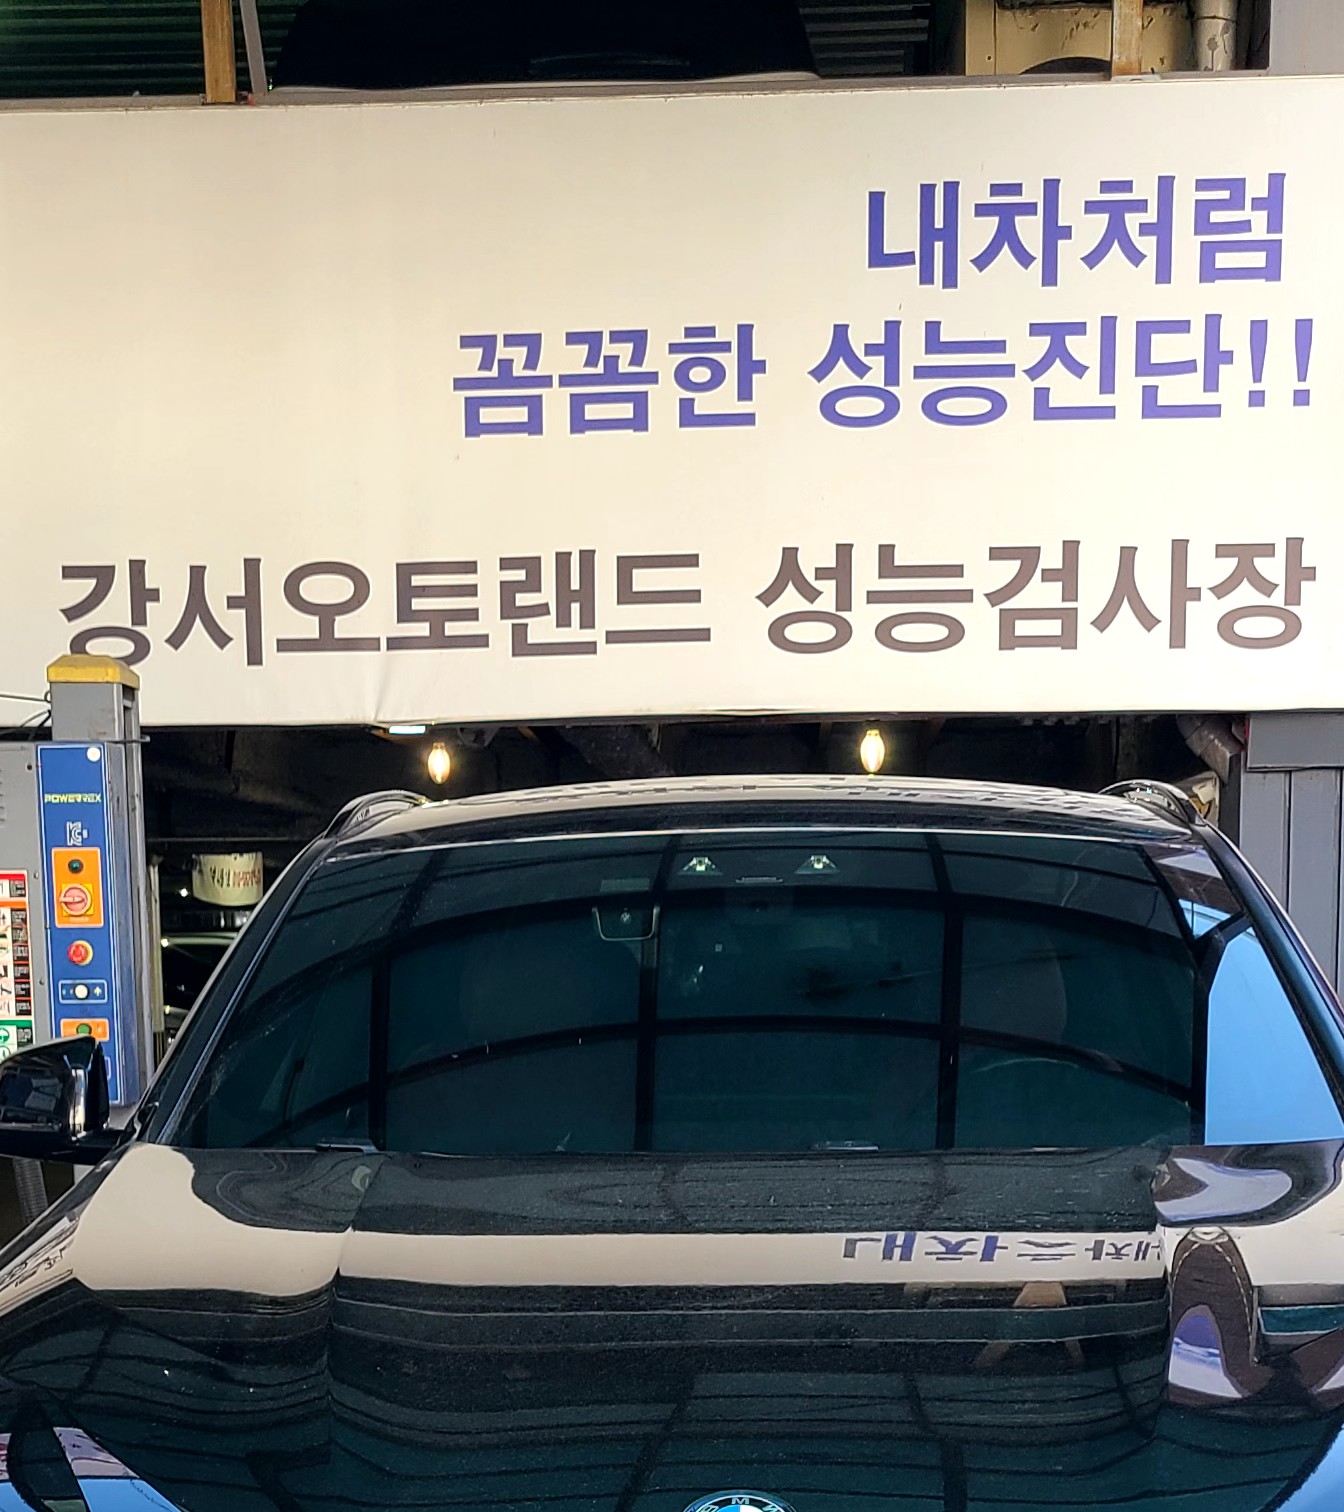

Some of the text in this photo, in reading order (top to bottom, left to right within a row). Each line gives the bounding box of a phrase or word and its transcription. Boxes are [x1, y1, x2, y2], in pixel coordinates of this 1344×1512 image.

[865, 171, 1287, 290] 내차처럼
[452, 312, 1315, 439] 꼼꼼한 성능진단!!
[58, 535, 1317, 668] 강서오토랜드 성능검사장
